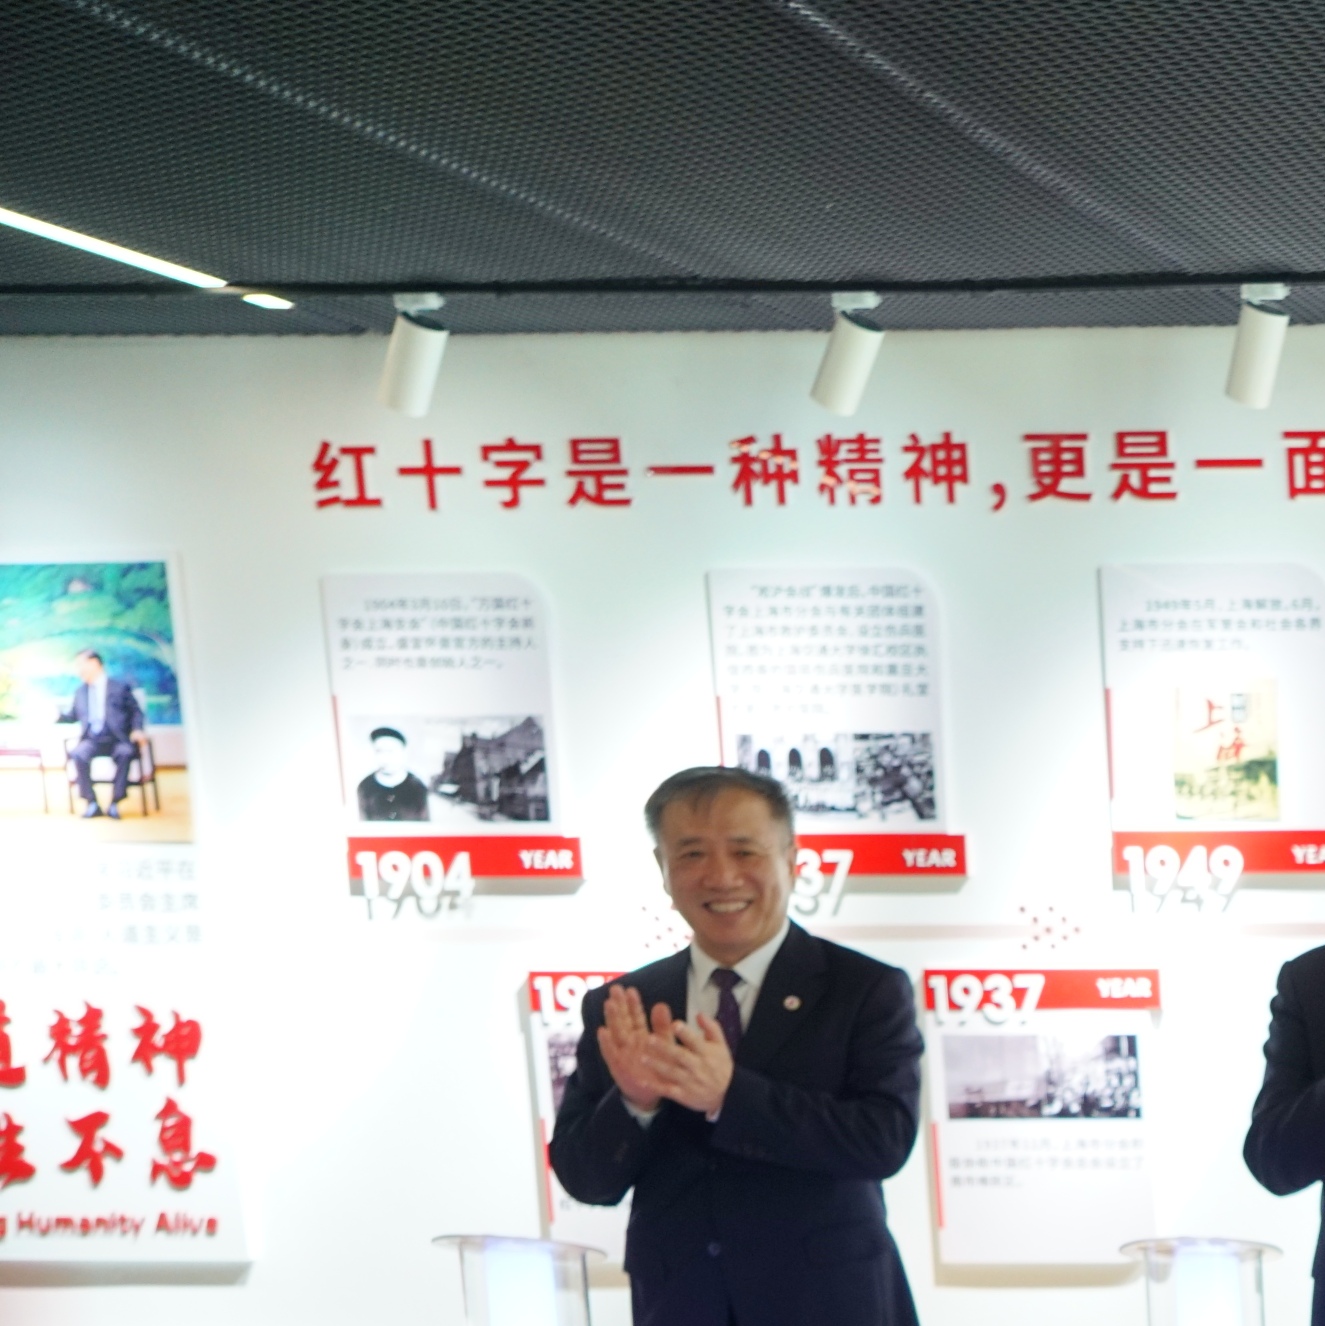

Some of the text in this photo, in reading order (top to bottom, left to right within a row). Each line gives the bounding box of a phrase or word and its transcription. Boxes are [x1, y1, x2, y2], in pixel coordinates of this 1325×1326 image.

[356, 850, 575, 898] 1904 YEAR
[794, 848, 957, 896] 37 YEAR
[1123, 845, 1244, 893] 1949
[928, 973, 1153, 1024] 1937 YEAR
[17, 1211, 145, 1242] Humanity
[156, 1212, 219, 1237] Alive
